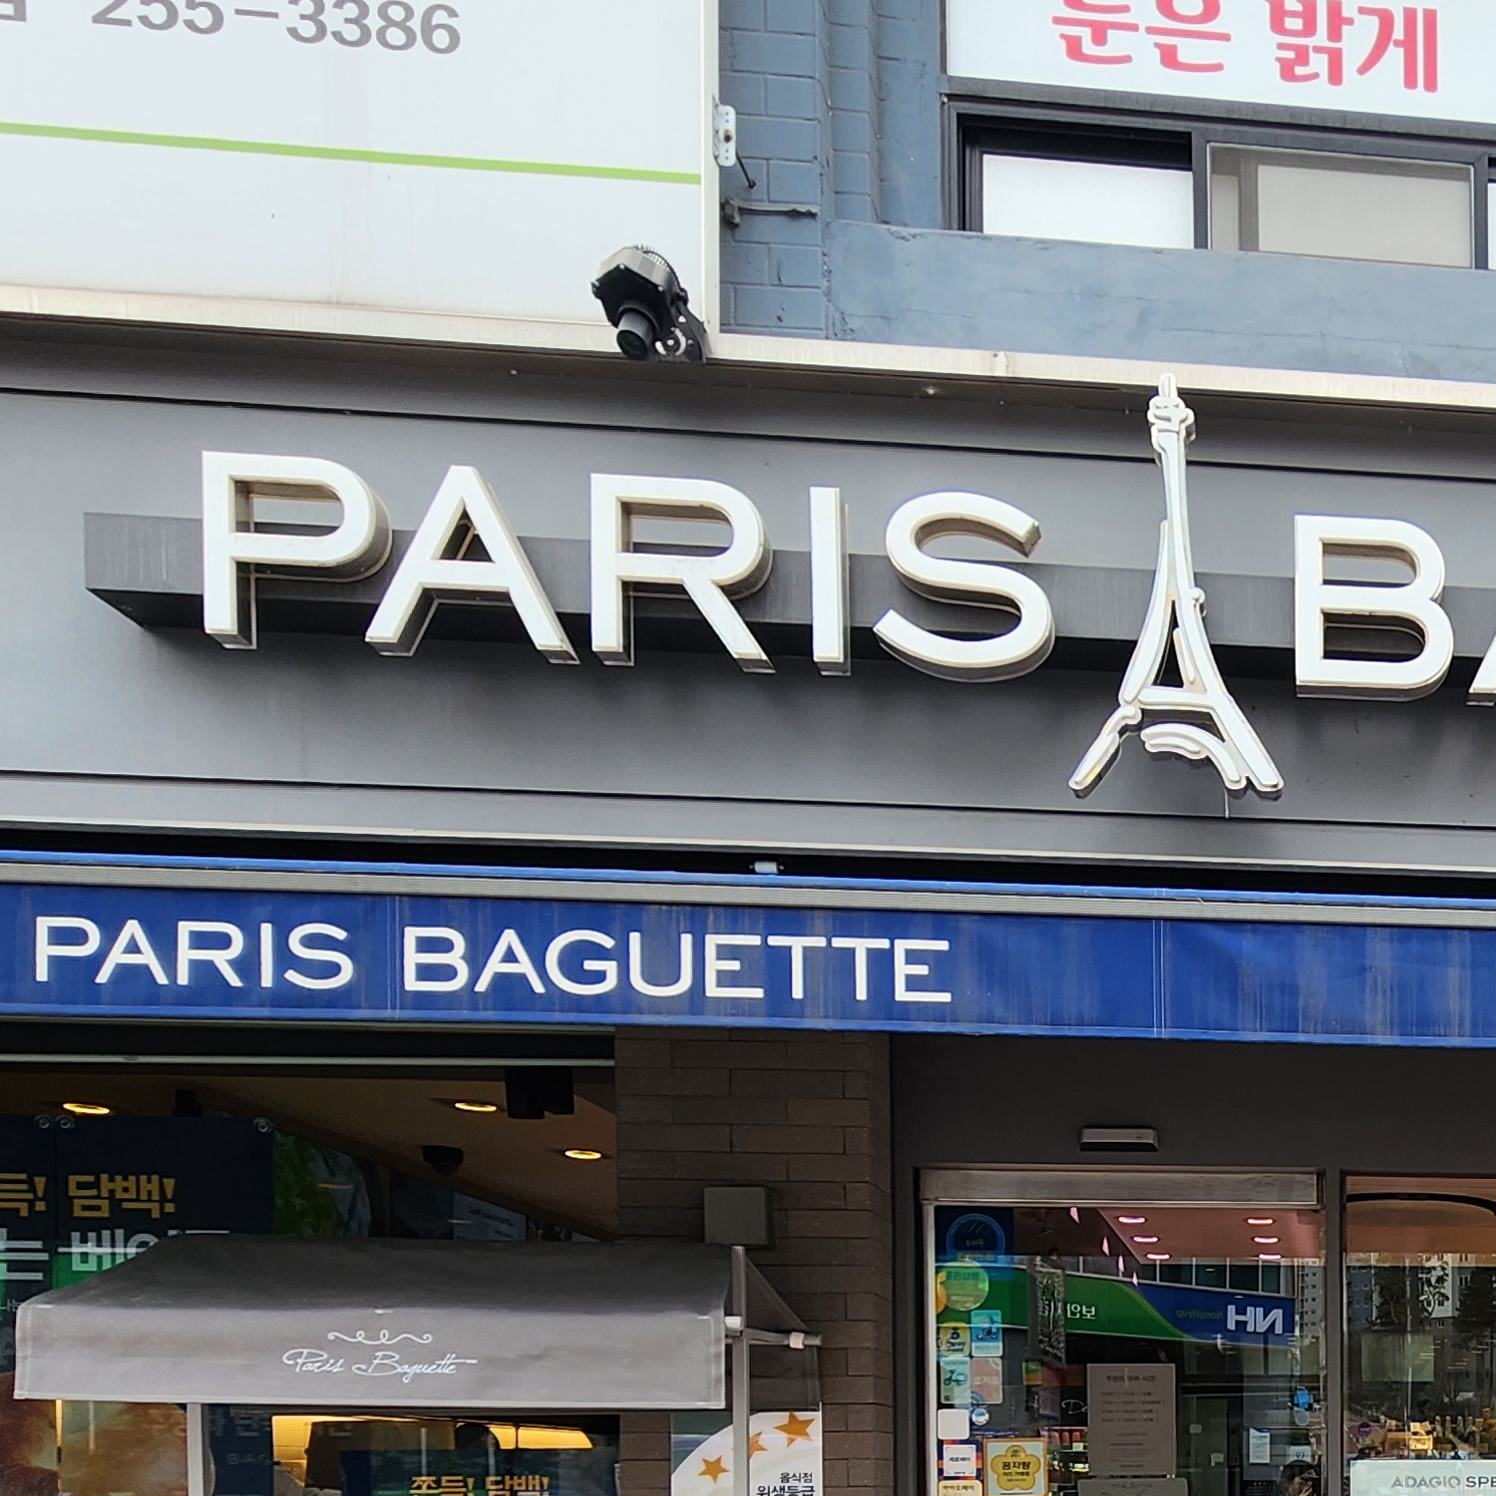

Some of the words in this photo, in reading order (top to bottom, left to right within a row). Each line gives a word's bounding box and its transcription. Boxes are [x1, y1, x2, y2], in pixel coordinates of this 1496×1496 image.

[92, 0, 462, 55] 255-3386
[1051, 0, 1232, 73] 눈은
[1265, 0, 1438, 93] 밝게
[202, 450, 1057, 681] PARIS
[33, 916, 355, 991] PARIS
[403, 926, 953, 1004] BAGUETTE
[68, 1173, 176, 1218] 담백!
[282, 1349, 345, 1373] Paris
[352, 1351, 478, 1383] Baguette
[1391, 1476, 1462, 1489] ADAGIO
